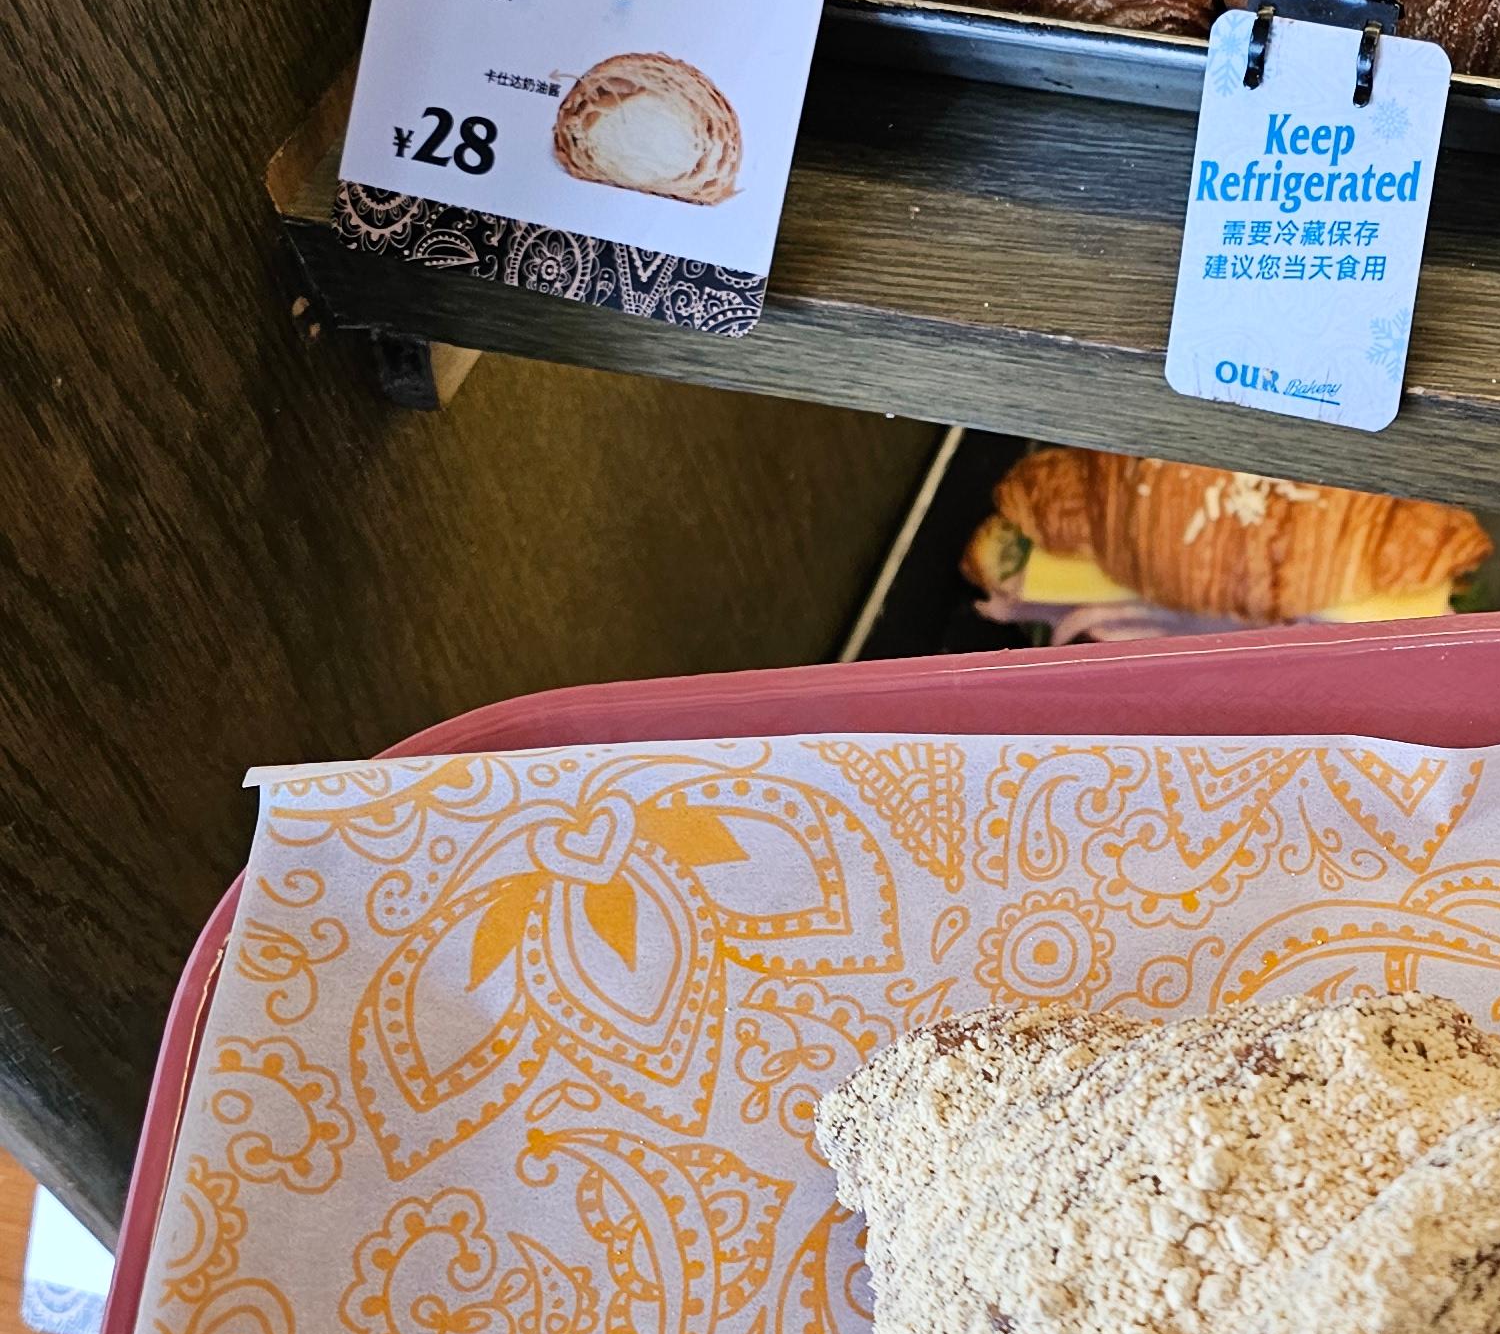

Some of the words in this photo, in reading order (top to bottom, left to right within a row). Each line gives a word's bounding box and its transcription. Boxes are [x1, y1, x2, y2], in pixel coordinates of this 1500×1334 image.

[484, 69, 562, 97] 卡仕达奶油酱
[392, 106, 498, 175] ¥28
[1264, 113, 1356, 166] Keep
[1196, 160, 1422, 213] Refrigerated
[1222, 220, 1380, 247] 需要冷藏保存
[1203, 254, 1387, 281] 建议您当天食用
[1215, 360, 1280, 394] OUR
